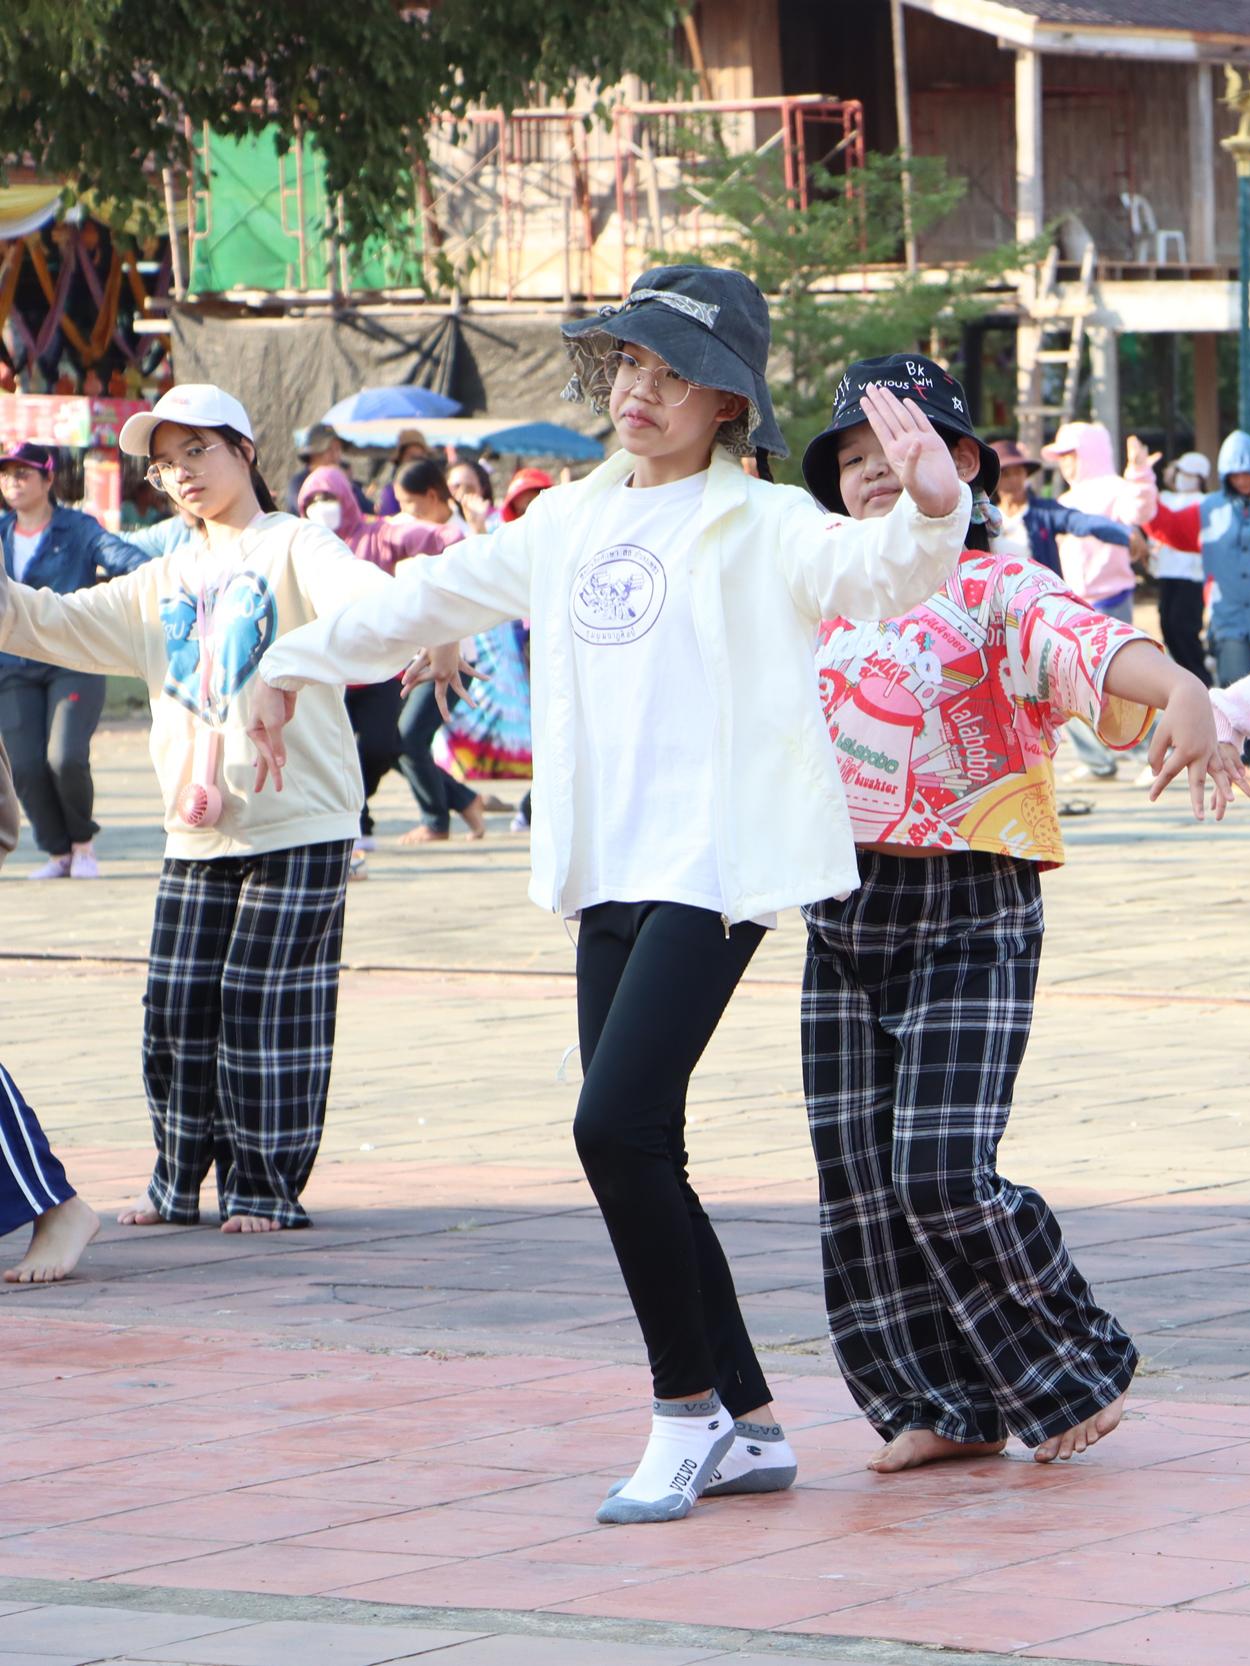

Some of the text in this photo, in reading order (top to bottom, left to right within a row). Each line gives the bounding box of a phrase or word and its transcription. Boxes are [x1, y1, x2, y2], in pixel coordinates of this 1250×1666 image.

[858, 380, 910, 391] VRIOUS
[946, 696, 997, 781] lalabobo
[669, 1458, 698, 1492] VOLVO
